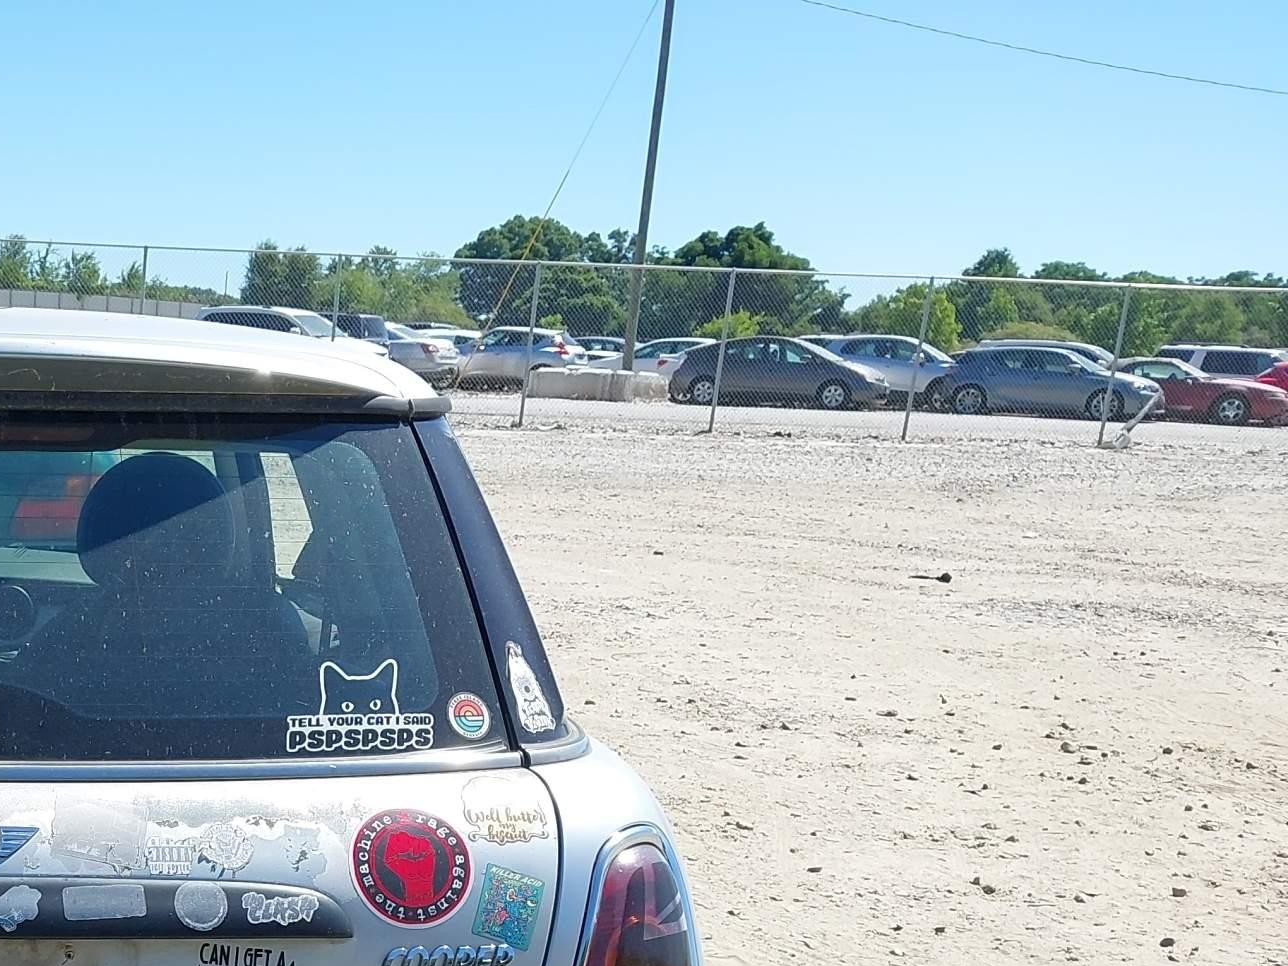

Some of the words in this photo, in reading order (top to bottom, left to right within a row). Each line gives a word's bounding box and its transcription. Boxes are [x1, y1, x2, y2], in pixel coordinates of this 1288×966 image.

[290, 716, 323, 728] TELL
[327, 716, 363, 727] YOUR
[367, 715, 391, 726] CAT
[395, 715, 400, 726] I
[403, 715, 432, 726] SAID
[288, 728, 433, 749] PSPSPSPS
[415, 813, 458, 847] rage
[358, 814, 393, 888] machine
[416, 853, 466, 922] against
[490, 866, 521, 881] KILLER
[520, 877, 543, 888] ACID
[374, 892, 407, 921] the
[200, 942, 231, 966] CAN
